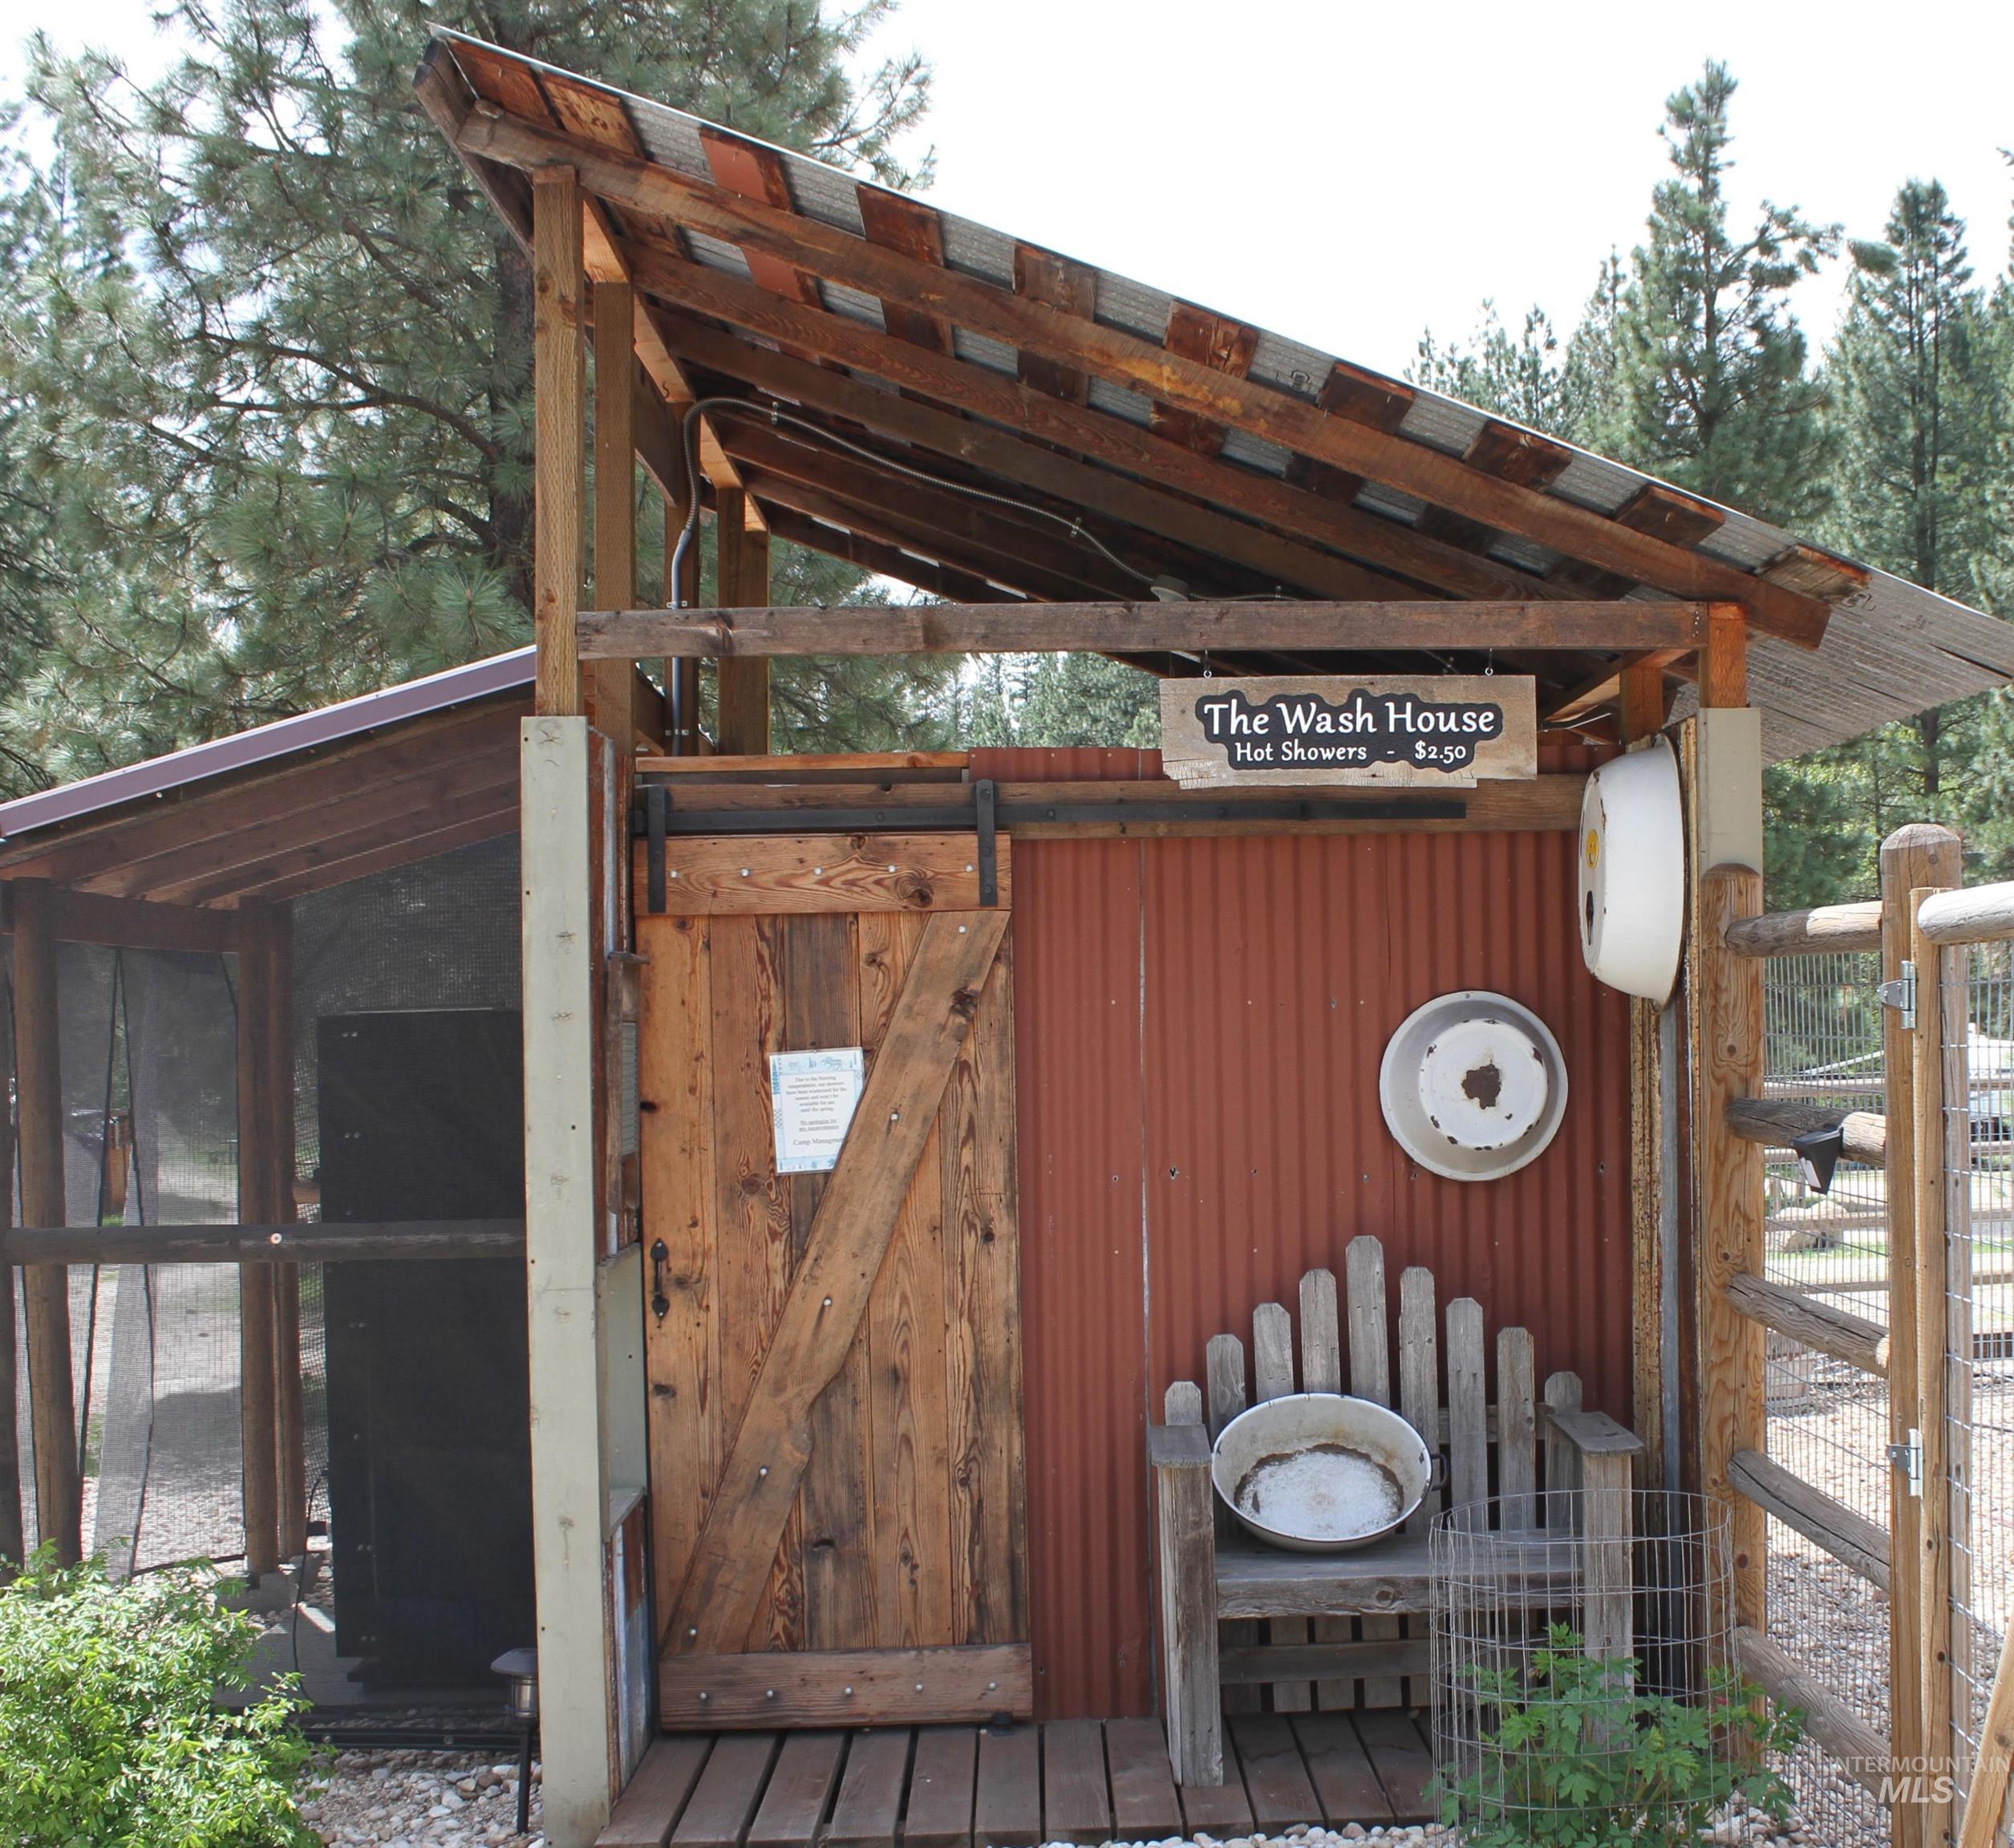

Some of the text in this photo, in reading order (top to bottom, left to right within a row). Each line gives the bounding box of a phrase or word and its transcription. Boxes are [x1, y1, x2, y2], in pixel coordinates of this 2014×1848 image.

[1204, 697, 1495, 736] The Wash House
[1235, 741, 1273, 762] Hot
[1281, 740, 1368, 761] Showers
[1414, 740, 1467, 764] $2.50
